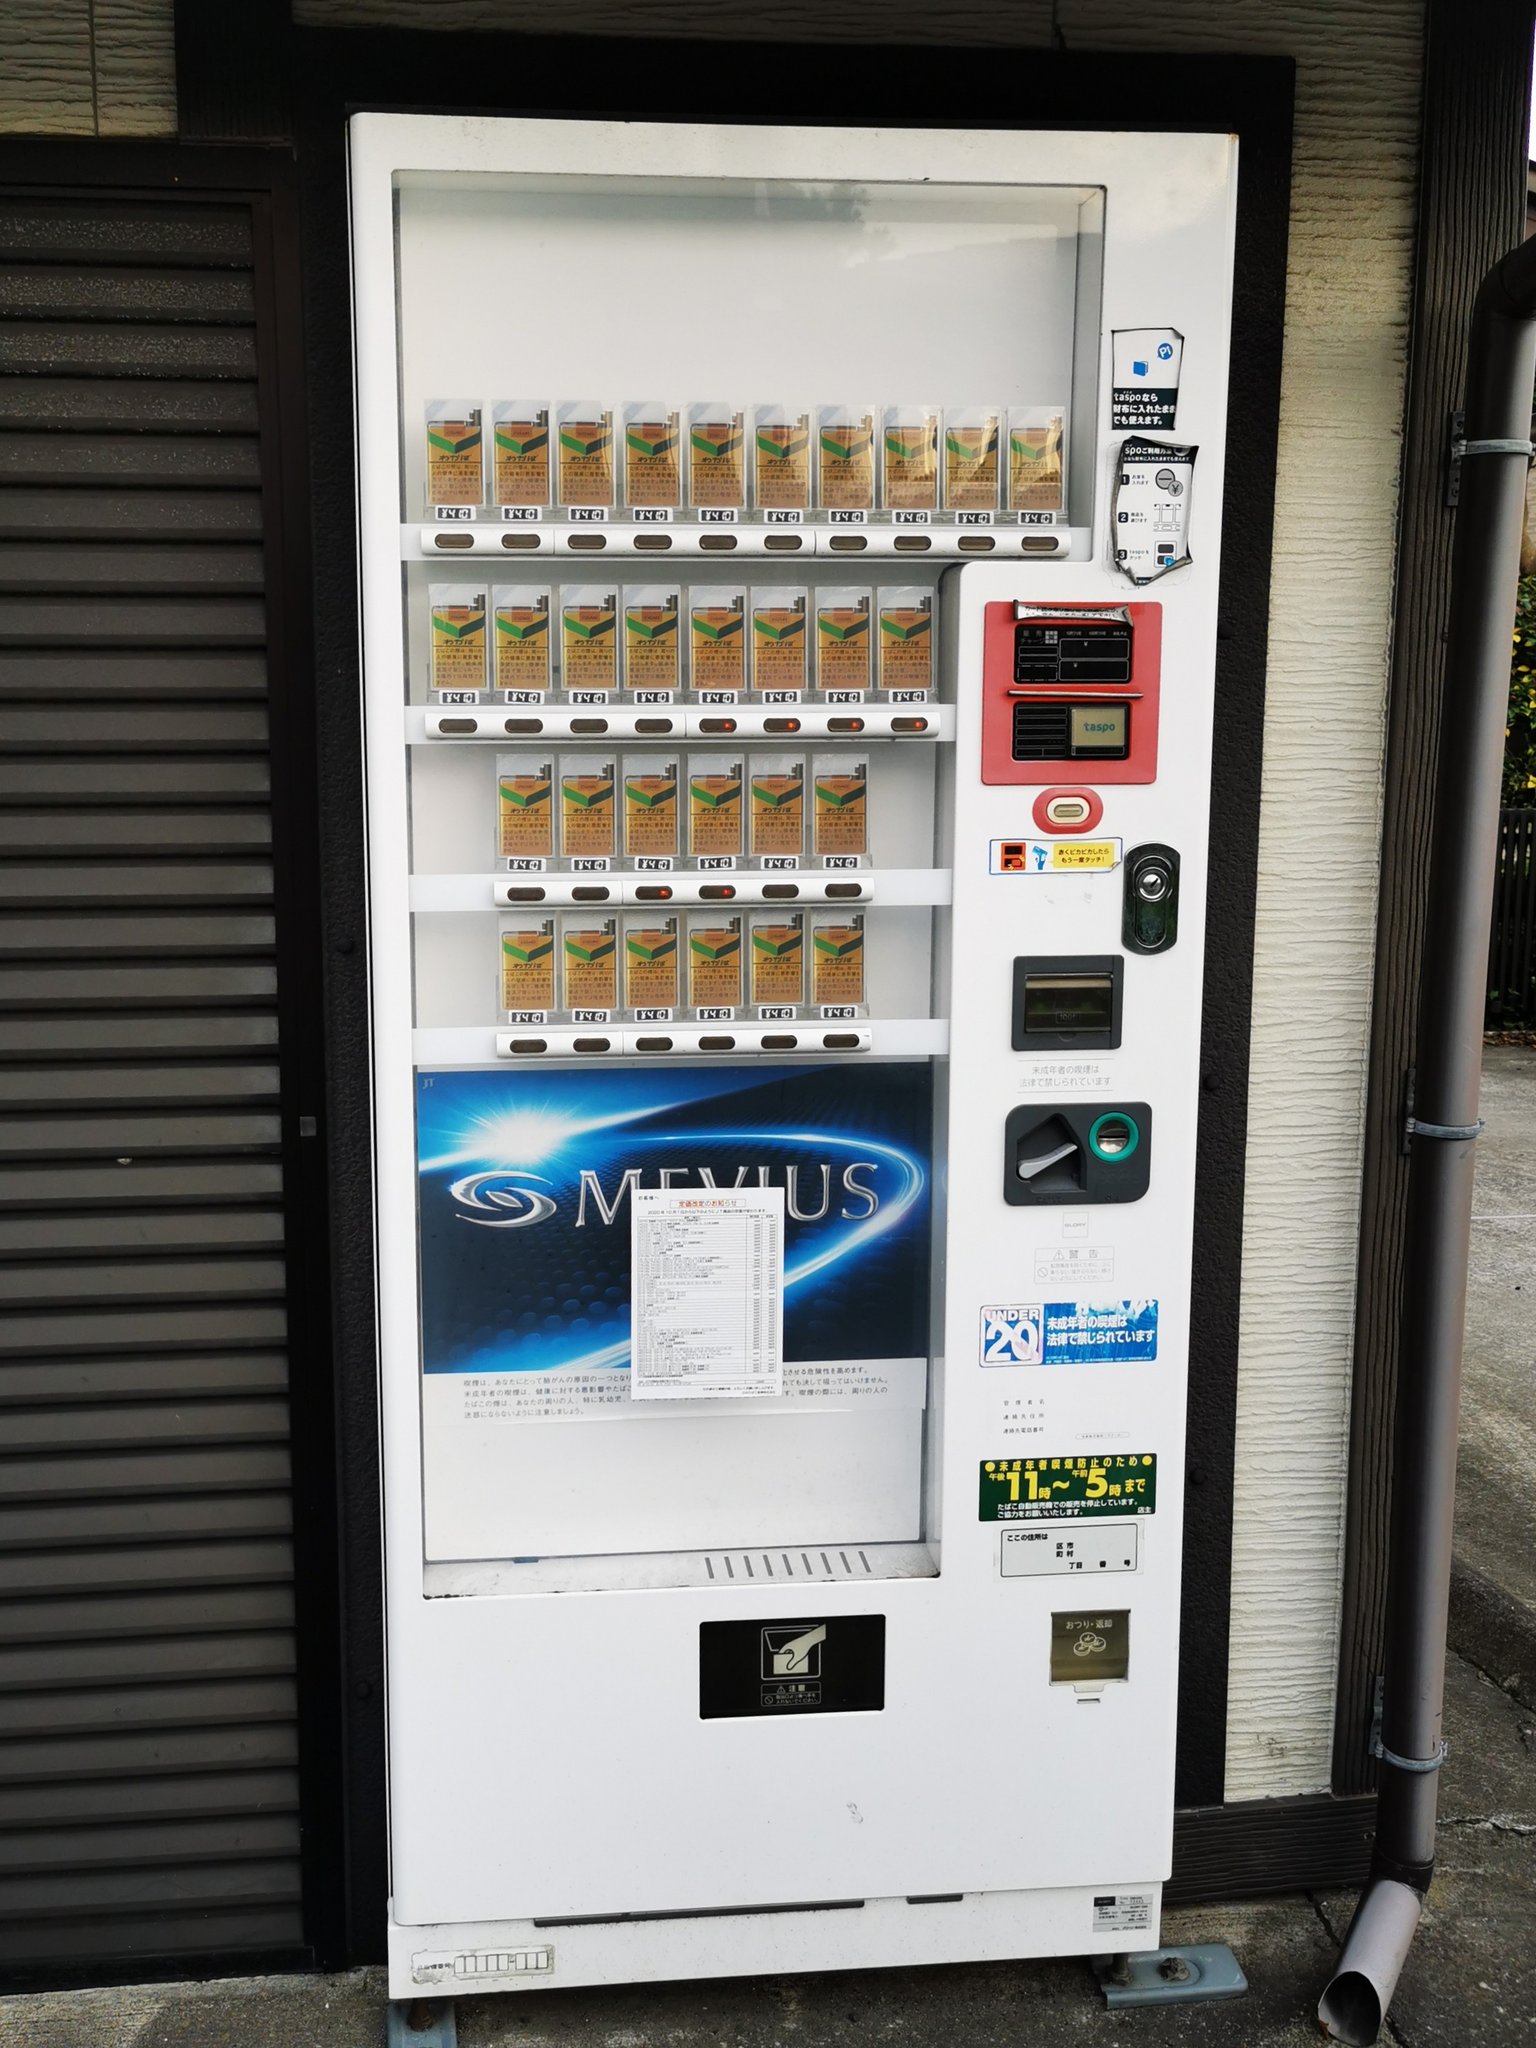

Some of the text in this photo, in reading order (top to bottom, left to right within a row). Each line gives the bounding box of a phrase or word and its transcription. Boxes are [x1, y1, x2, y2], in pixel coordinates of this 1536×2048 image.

[1114, 393, 1158, 402] taspoなら
[1114, 416, 1162, 425] でも使えます。
[442, 508, 468, 518] ¥410
[509, 509, 534, 519] ¥410
[576, 509, 601, 520] ¥410
[640, 510, 665, 520] ¥410
[706, 510, 731, 521] ¥410
[772, 512, 797, 522] ¥410
[836, 511, 860, 522] ¥410
[900, 512, 925, 522] ¥410
[963, 513, 987, 523] ¥410
[1025, 513, 1049, 523] ¥410
[1120, 514, 1126, 522] 2
[1119, 551, 1125, 559] 3
[447, 693, 472, 703] ¥410
[510, 691, 538, 703] ¥410
[577, 693, 602, 703] ¥410
[642, 691, 667, 703] ¥410
[707, 693, 731, 703] ¥410
[770, 692, 794, 702] ¥410
[833, 692, 857, 702] ¥410
[898, 692, 925, 702] ¥410
[1084, 722, 1116, 733] taspo
[513, 860, 538, 870] ¥410
[579, 860, 603, 870] ¥410
[643, 859, 667, 869] ¥410
[705, 858, 729, 868] ¥410
[768, 859, 793, 868] ¥410
[830, 857, 854, 867] ¥410
[516, 1013, 541, 1022] ¥410
[580, 1011, 604, 1021] ¥410
[642, 1010, 665, 1020] ¥410
[704, 1009, 728, 1019] ¥410
[766, 1008, 790, 1018] ¥410
[828, 1008, 852, 1017] ¥410
[1032, 1065, 1099, 1074] 未成年者の喫煙は
[1020, 1078, 1112, 1088] 法律で禁じられています
[1047, 1315, 1127, 1329] 未成年者の喫煙は
[986, 1321, 1039, 1361] 20
[1047, 1330, 1155, 1346] 法律で禁じられています
[1000, 1456, 1138, 1471] 未成年者喫煙防止のため
[998, 1499, 1138, 1511] たばこ自動販売機での販売を停止しています。
[1137, 1506, 1152, 1514] 店主
[998, 1509, 1083, 1519] ご協力をお願いいたします。
[1007, 1533, 1048, 1541] ここの住所は
[1066, 1620, 1113, 1630] おつり・返却
